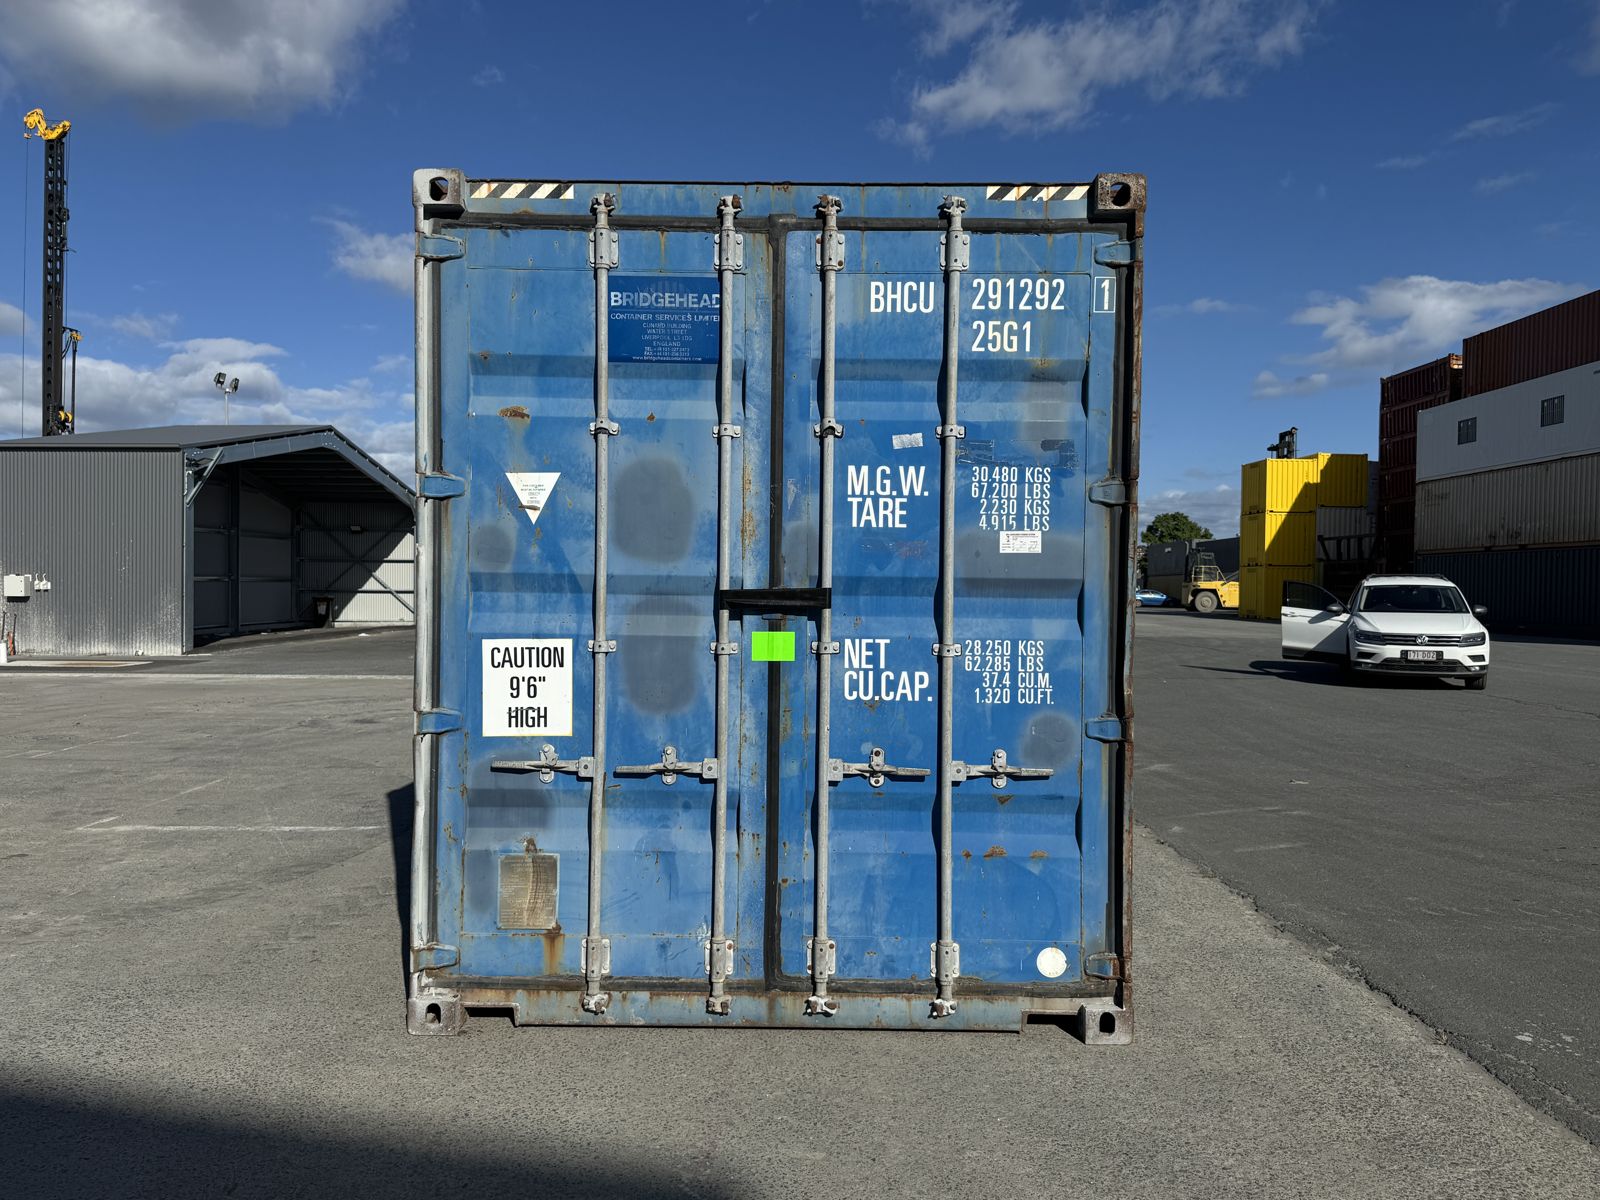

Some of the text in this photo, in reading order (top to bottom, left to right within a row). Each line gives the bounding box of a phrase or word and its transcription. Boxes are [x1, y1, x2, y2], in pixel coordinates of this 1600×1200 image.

[870, 278, 1110, 313] BHCU 291292 1
[610, 312, 720, 322] CONTAINER SERVICES LIMITE
[971, 320, 1031, 352] 25G1
[847, 465, 929, 496] M.G.W.
[1025, 466, 1051, 483] KGS
[1024, 483, 1050, 499] LBS
[847, 497, 908, 528] TARE
[1024, 499, 1050, 515] KGS
[1024, 516, 1050, 531] LBS
[490, 646, 564, 668] CAUTION
[844, 638, 891, 669] NET
[1018, 640, 1044, 656] KGS
[1018, 656, 1044, 672] LBS
[510, 676, 546, 699] 9'6"
[844, 671, 933, 702] CU.CAP.
[982, 672, 1053, 688] 37.4 CU.M.
[1018, 688, 1054, 705] CU.FT.
[508, 706, 548, 728] HIGH
